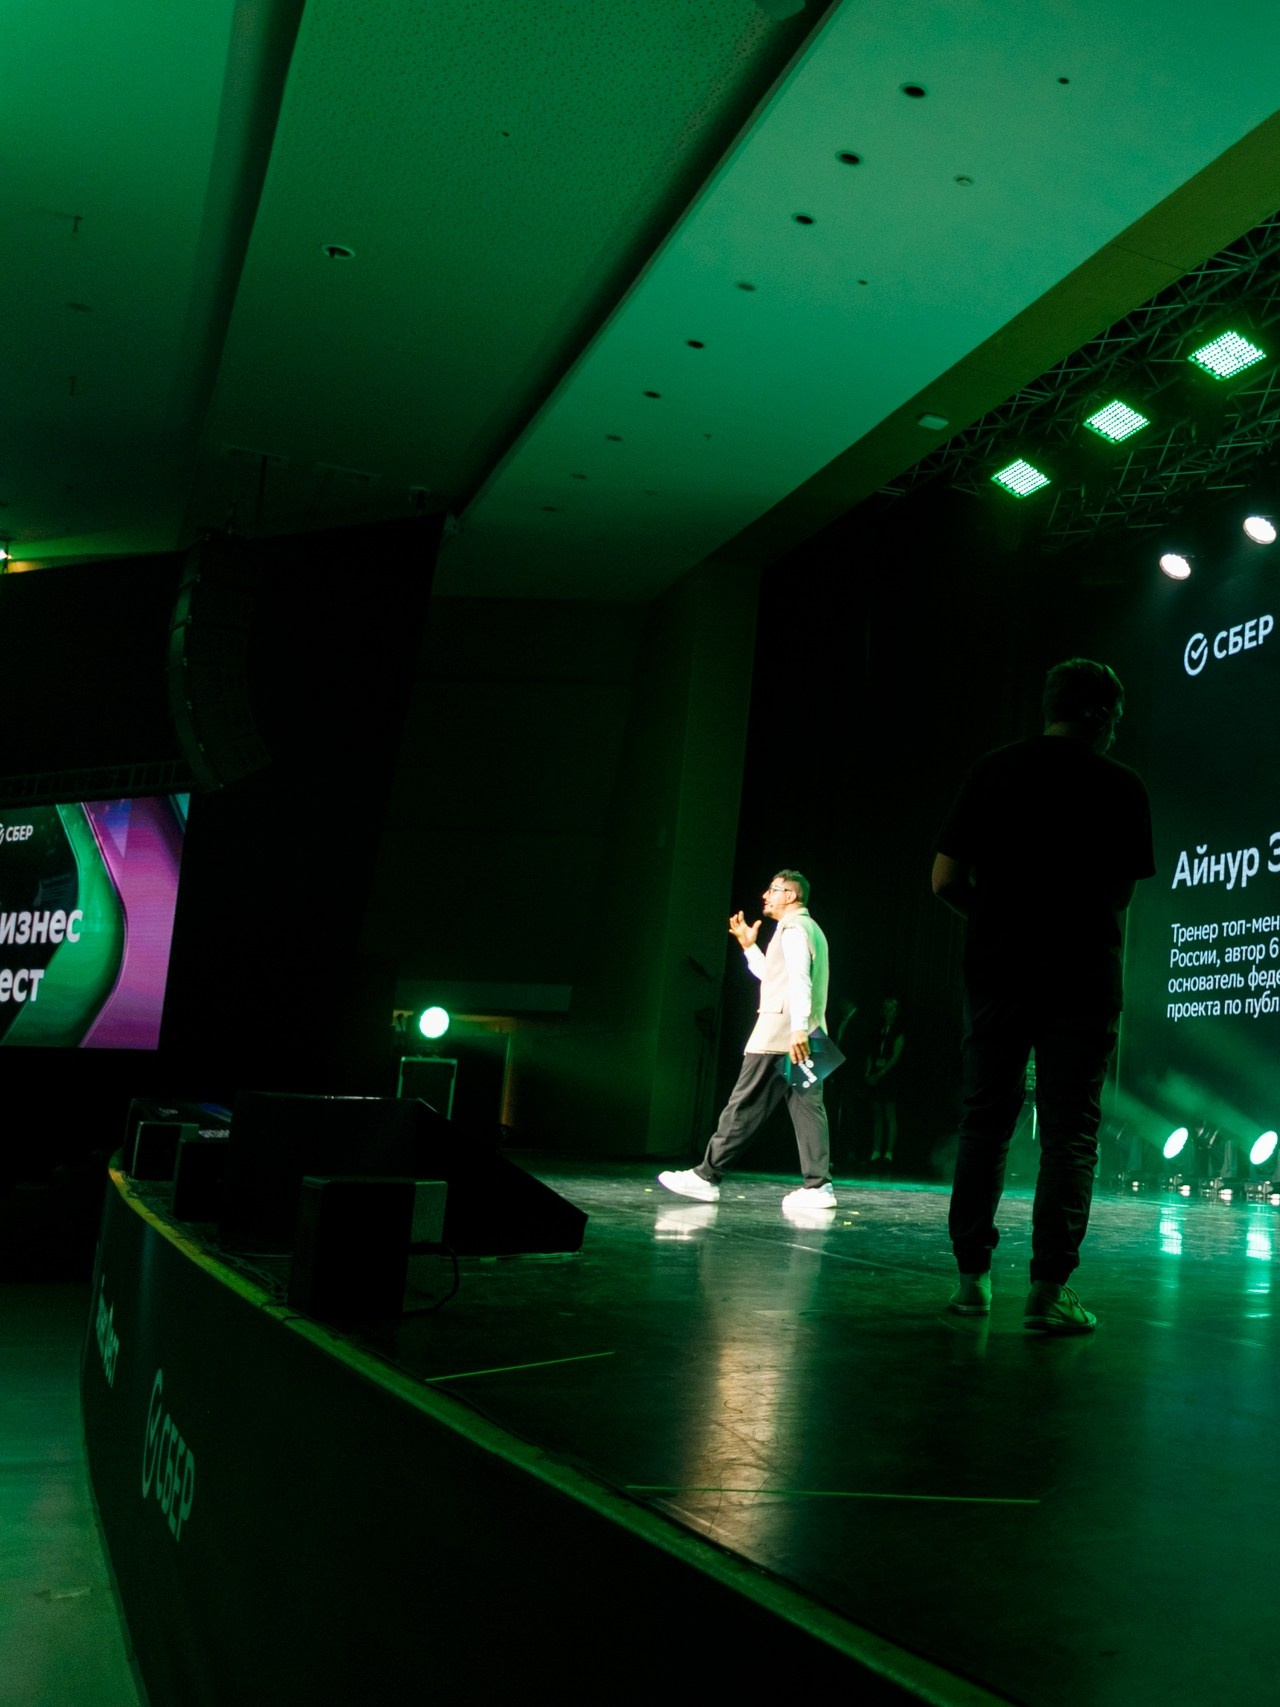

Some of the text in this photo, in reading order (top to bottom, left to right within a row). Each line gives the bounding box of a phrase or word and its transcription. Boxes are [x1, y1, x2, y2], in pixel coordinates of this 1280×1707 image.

[1214, 615, 1273, 658] СБЕР
[6, 825, 33, 841] СБЕР
[1172, 845, 1259, 890] Айнур
[1171, 923, 1218, 945] Тренер
[1170, 949, 1220, 968] России,
[1225, 944, 1265, 964] автор
[1168, 974, 1244, 992] основатель
[1168, 1001, 1220, 1022] проекта
[1224, 1000, 1241, 1014] по
[156, 1413, 195, 1543] СБЕР
